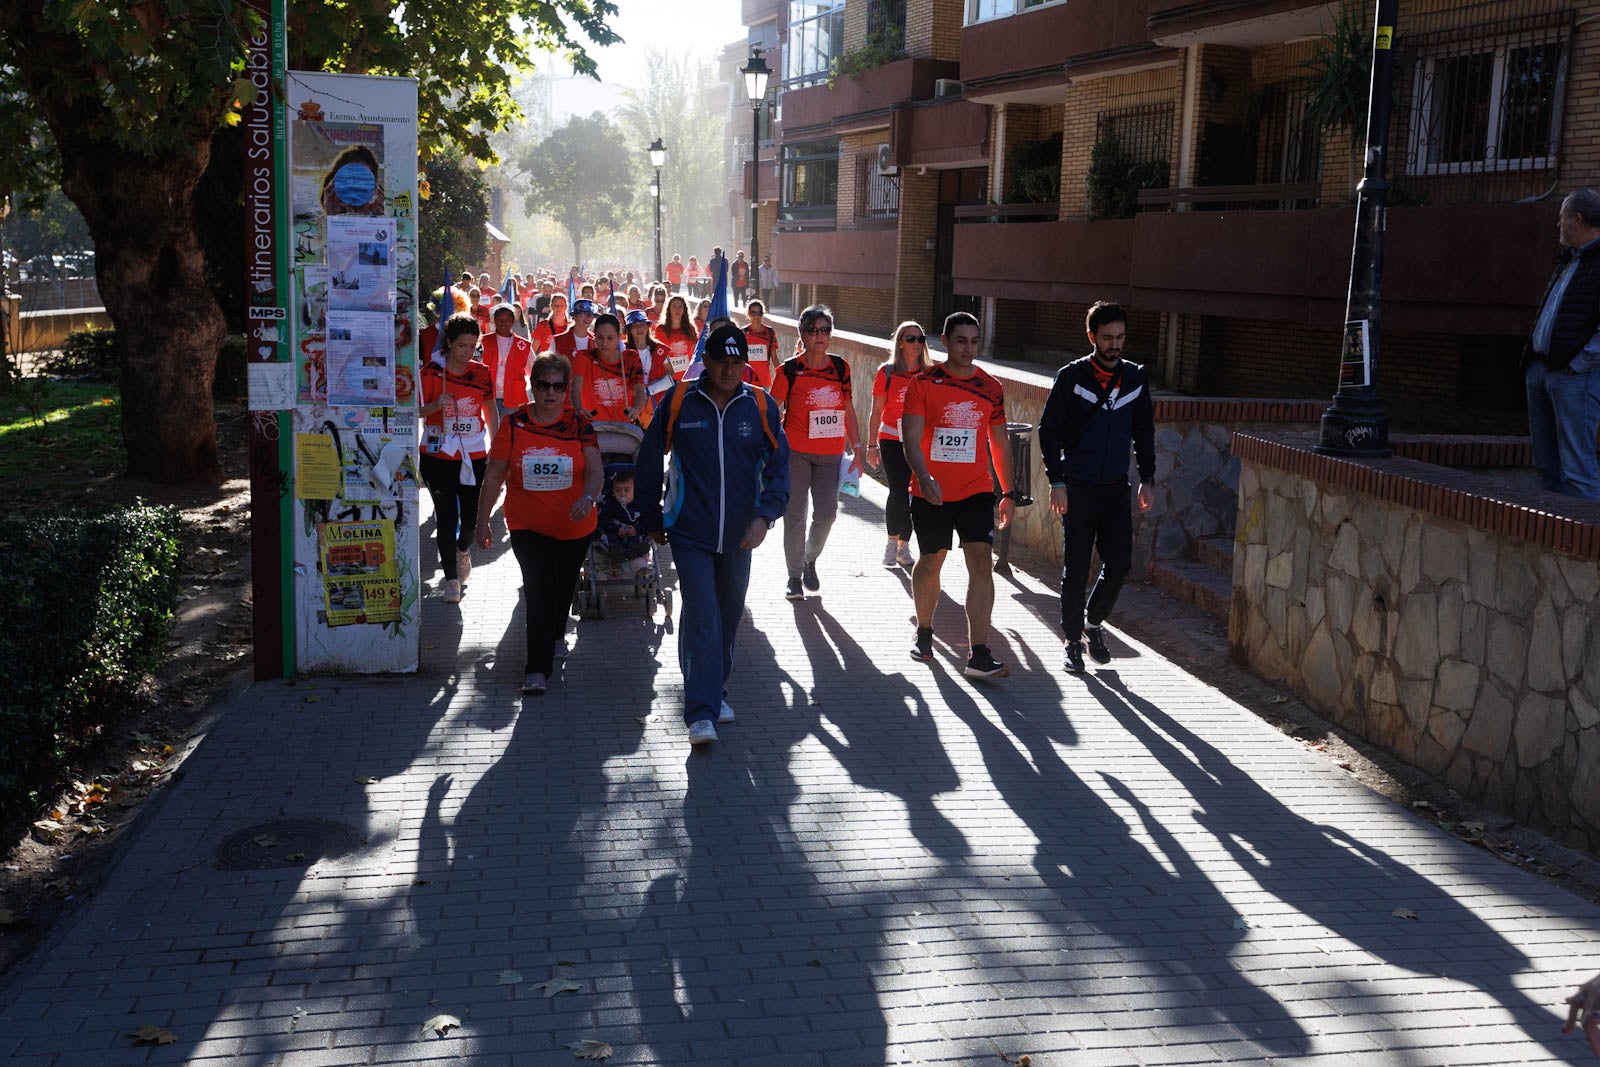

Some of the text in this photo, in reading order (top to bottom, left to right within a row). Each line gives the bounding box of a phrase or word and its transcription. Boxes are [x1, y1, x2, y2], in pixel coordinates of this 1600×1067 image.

[329, 111, 411, 125] Excmo. Ayuntamiento
[276, 119, 284, 140] Ruta
[251, 308, 284, 318] MPS
[814, 415, 838, 425] 1800
[452, 423, 472, 432] 859
[938, 435, 969, 447] 1297
[533, 463, 559, 475] 852
[365, 586, 398, 600] 149 €
